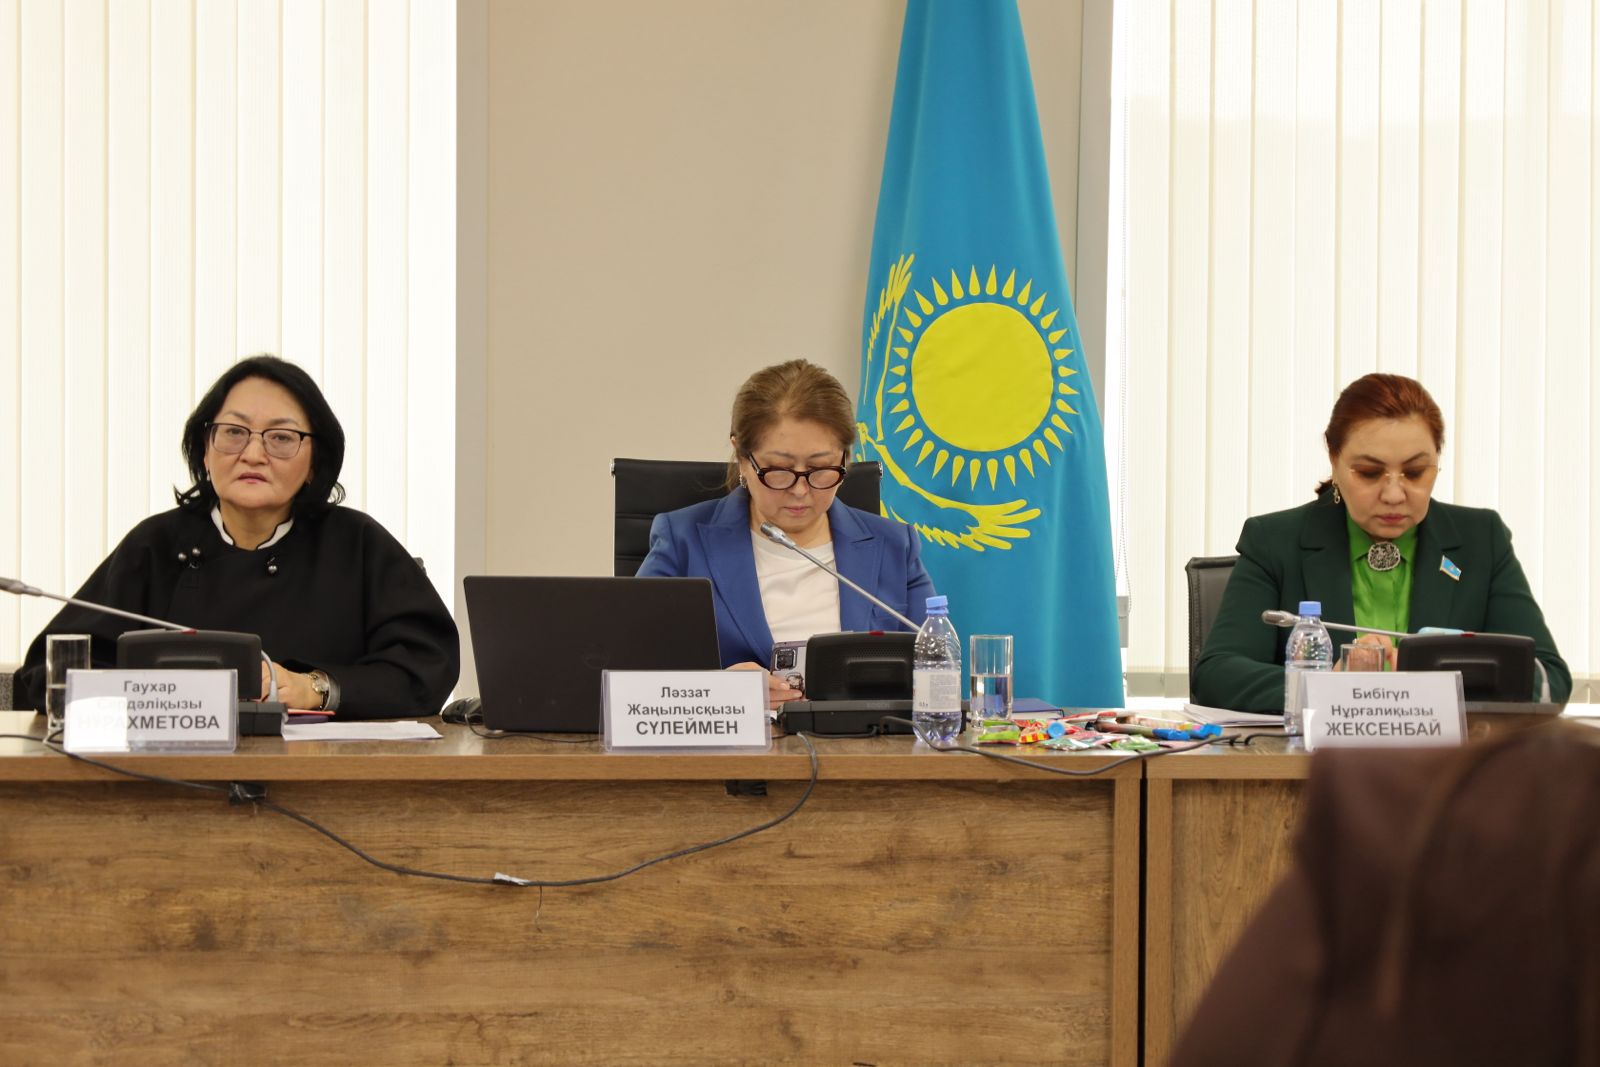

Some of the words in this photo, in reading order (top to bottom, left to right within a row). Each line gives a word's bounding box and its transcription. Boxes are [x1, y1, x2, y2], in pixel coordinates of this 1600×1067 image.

[123, 680, 177, 694] Гаухар
[661, 686, 711, 698] Ләззат
[1352, 687, 1410, 701] Бибігүл
[97, 698, 202, 711] Срдәліқызы
[627, 703, 745, 716] Жаңылысқызы
[1331, 705, 1433, 719] Нұрғалиқызы
[78, 714, 220, 730] НРАХМЕТОВА
[636, 717, 739, 735] СҮЛЕЙМЕН
[1325, 720, 1442, 737] ЖЕКСЕНБАЙ
